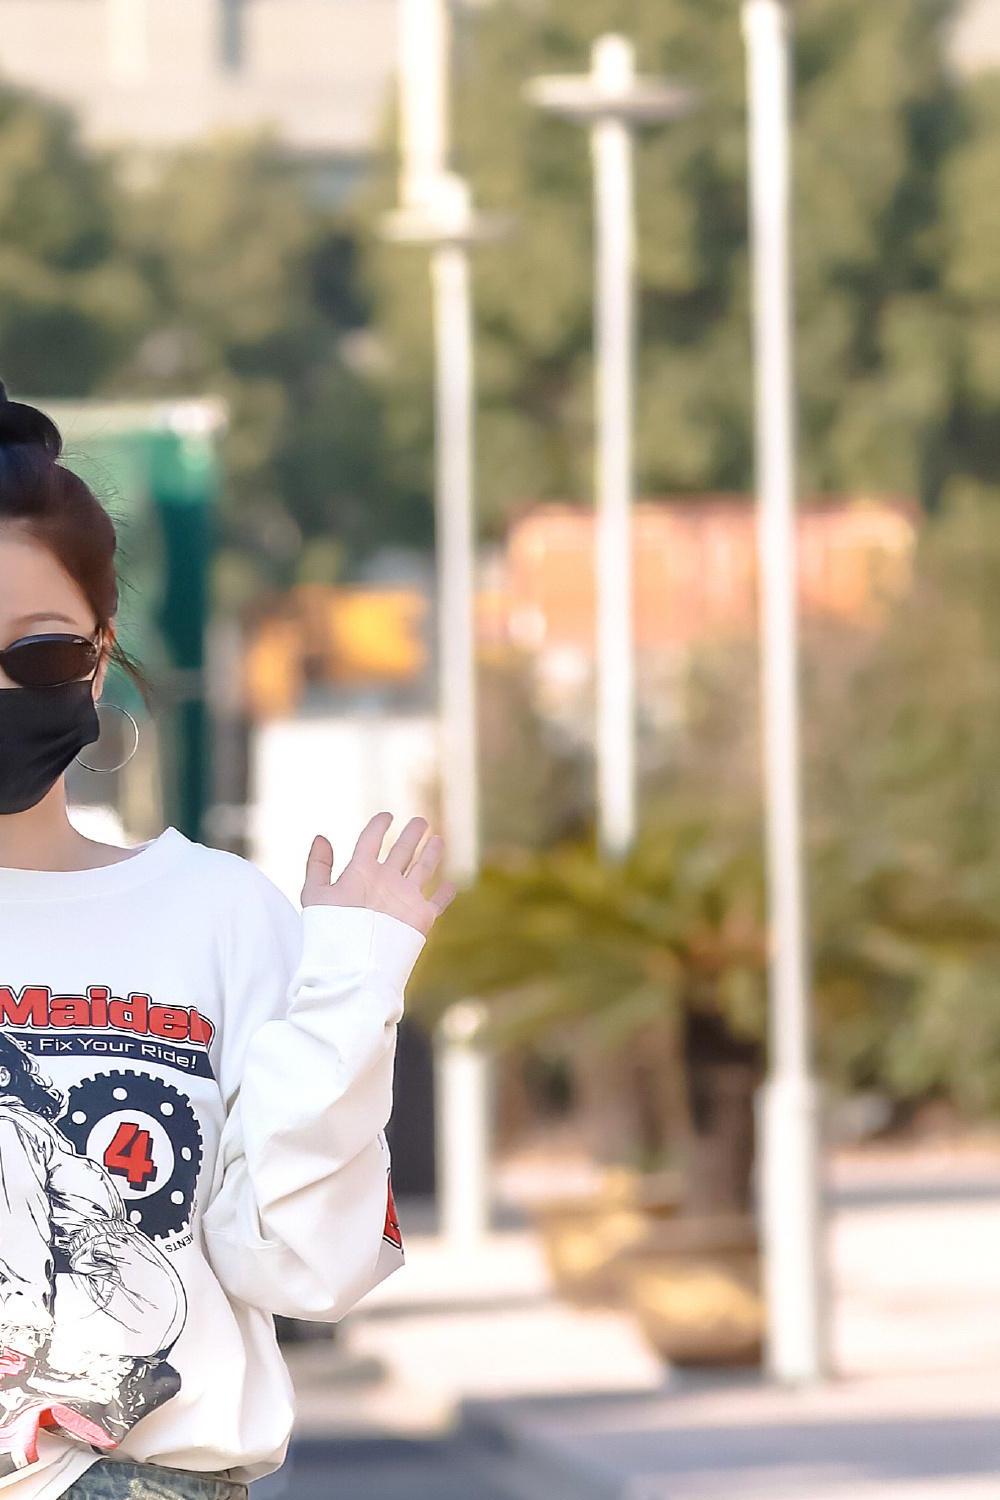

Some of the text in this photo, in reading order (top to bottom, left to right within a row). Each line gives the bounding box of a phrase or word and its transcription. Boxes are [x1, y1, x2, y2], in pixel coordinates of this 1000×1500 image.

[39, 1039, 73, 1051] Fix
[76, 1038, 135, 1053] Your
[141, 1044, 197, 1069] Ride!
[103, 1121, 158, 1191] 4
